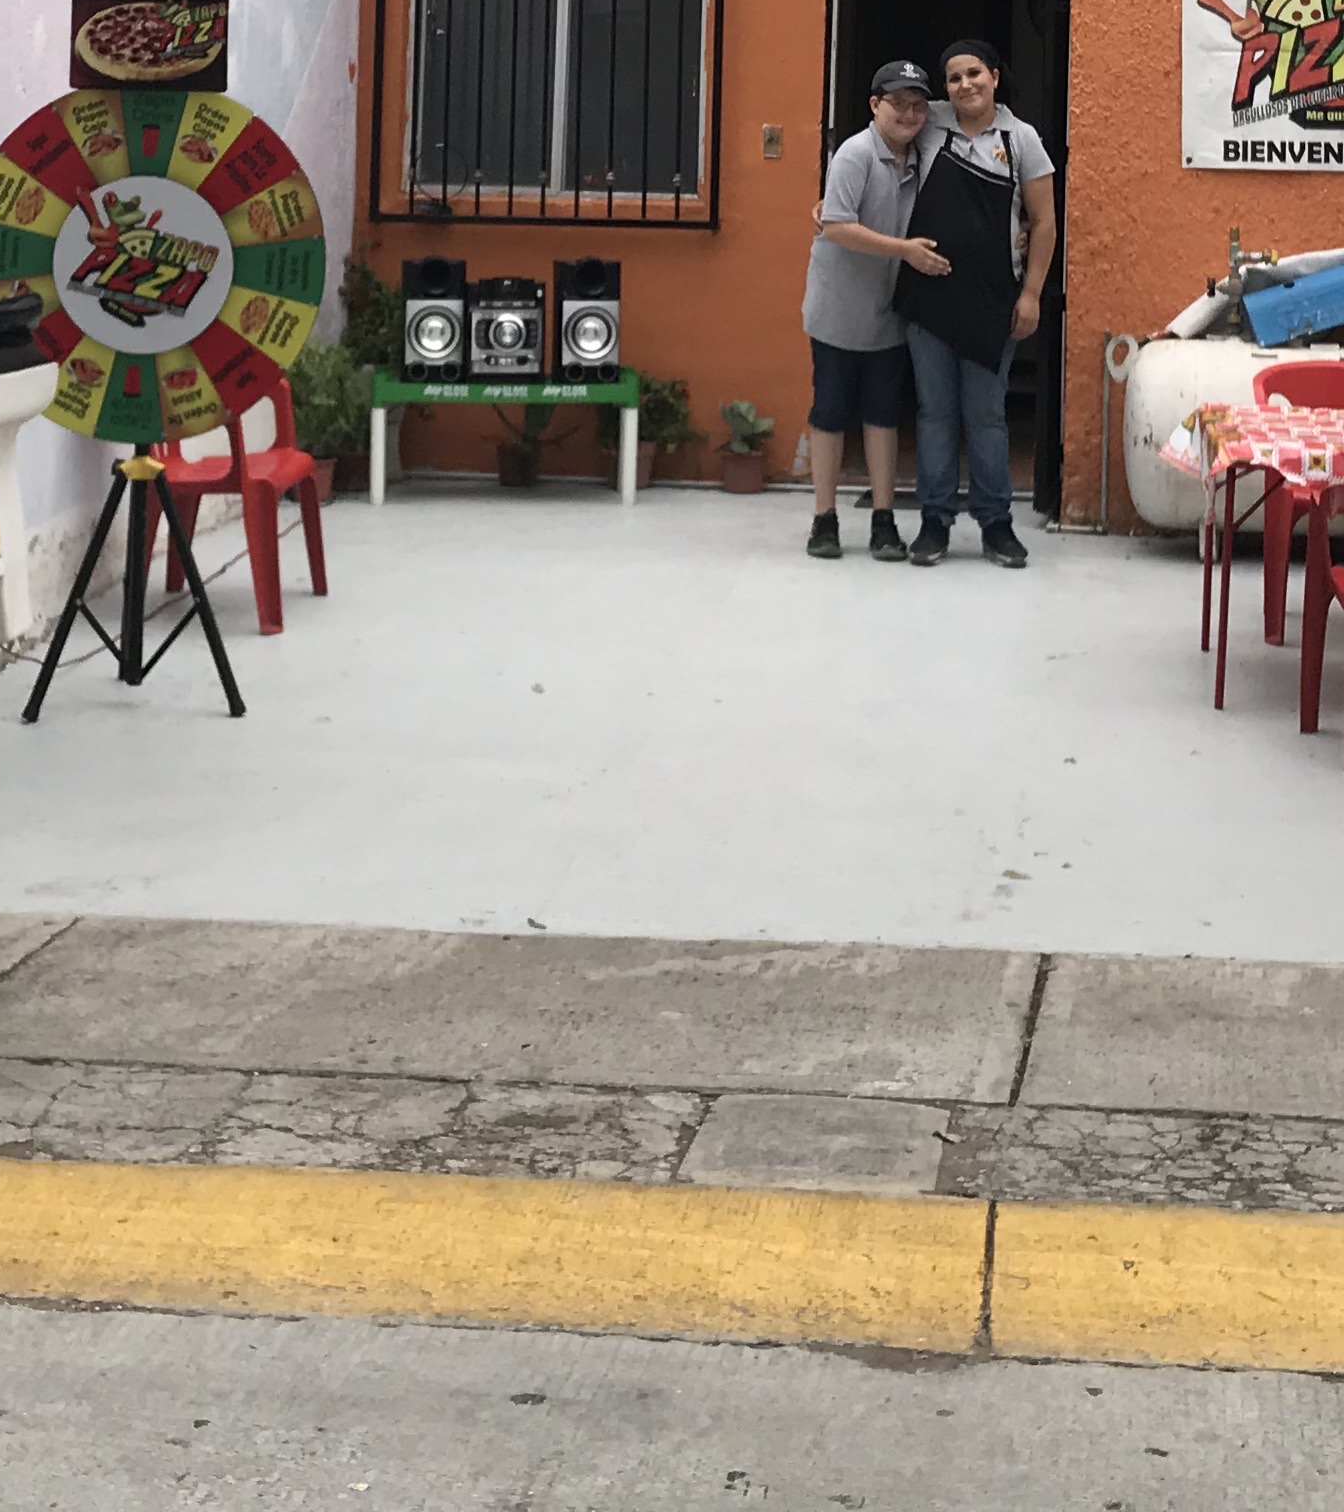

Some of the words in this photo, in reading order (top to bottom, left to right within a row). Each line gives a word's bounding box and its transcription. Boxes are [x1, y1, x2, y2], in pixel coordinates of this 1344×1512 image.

[196, 101, 232, 124] Orden
[1306, 109, 1324, 120] Me
[156, 232, 220, 273] ZAPO
[70, 247, 209, 309] PIZZA
